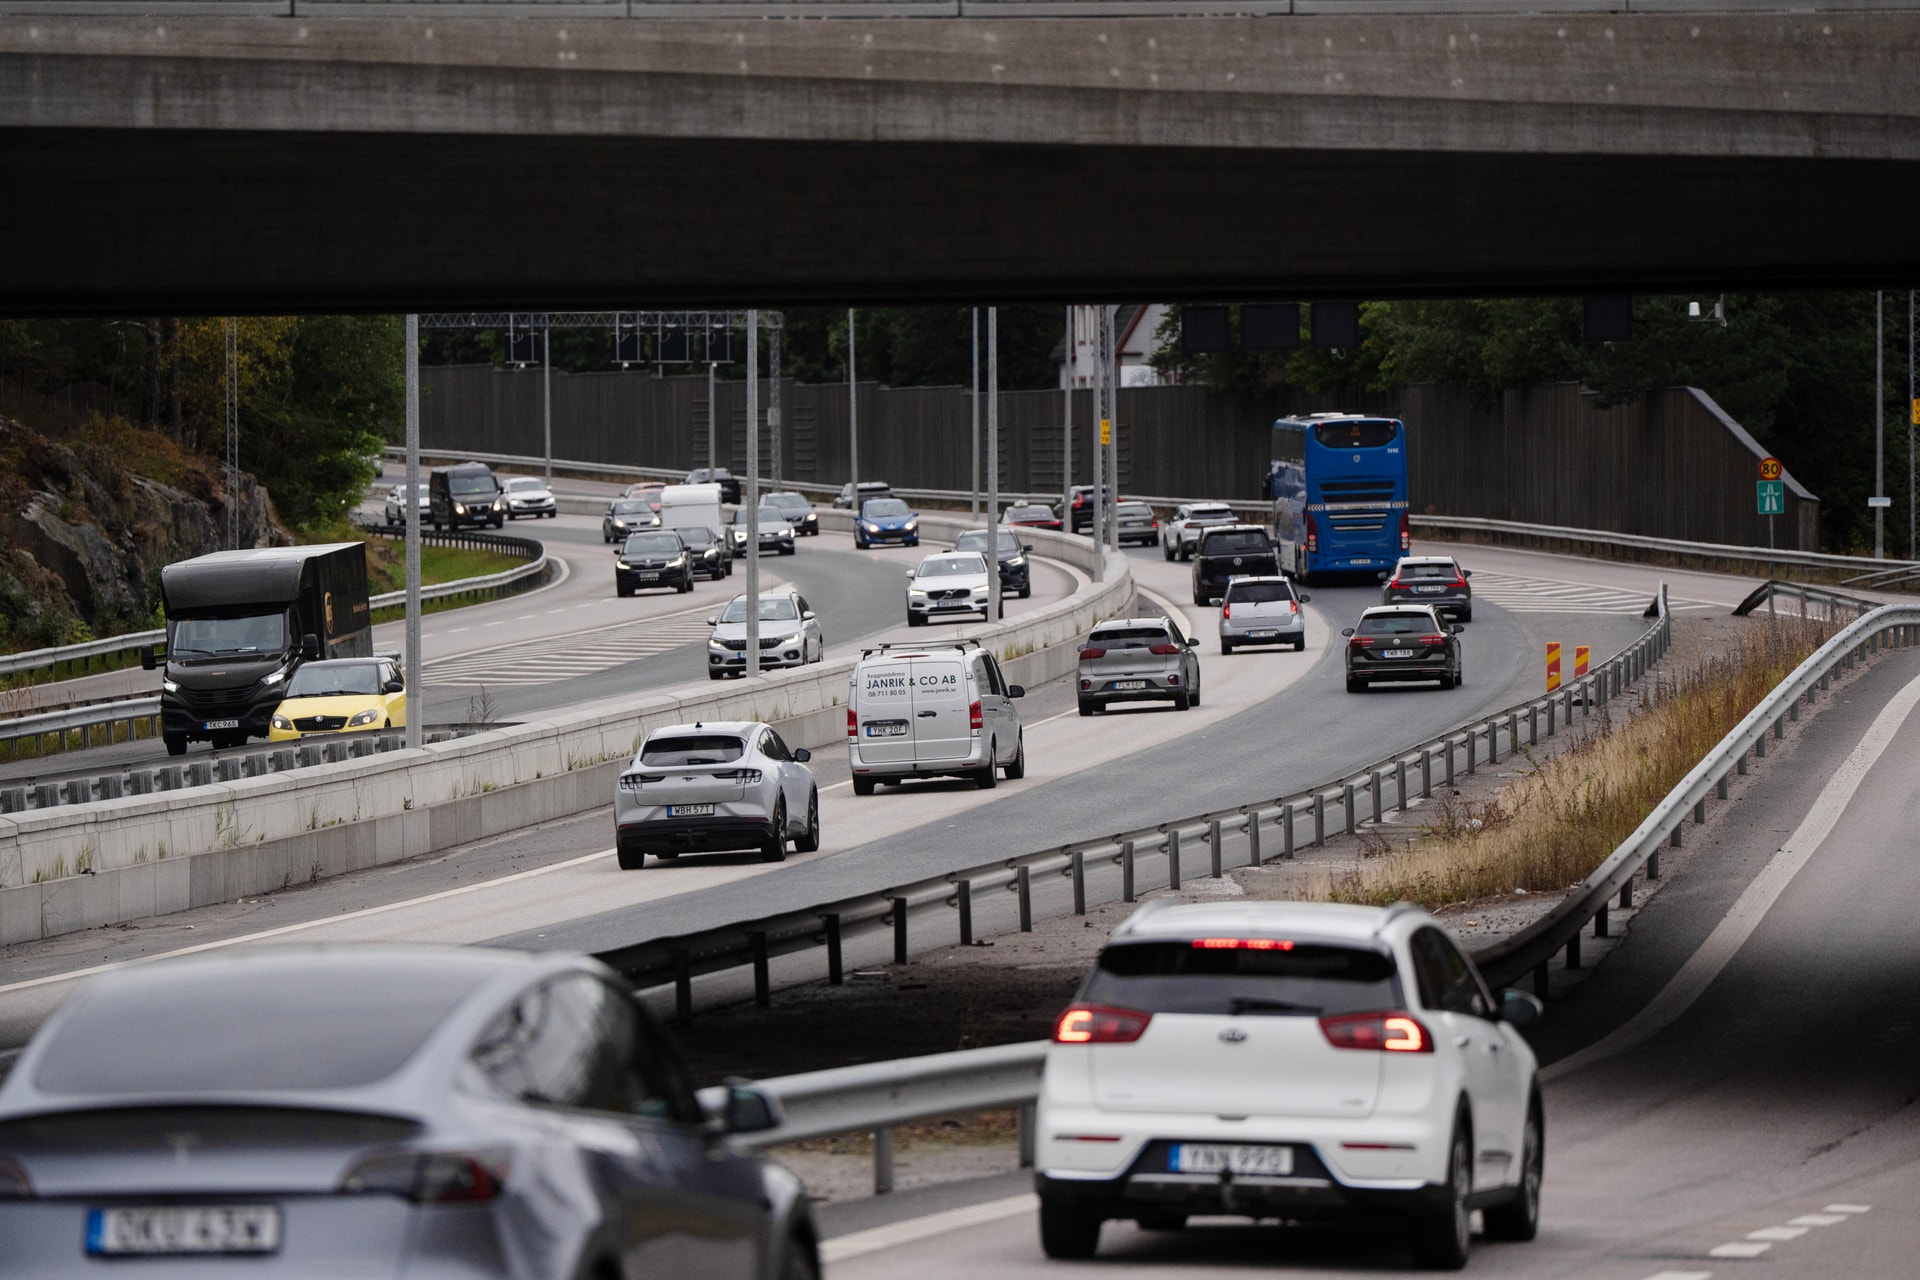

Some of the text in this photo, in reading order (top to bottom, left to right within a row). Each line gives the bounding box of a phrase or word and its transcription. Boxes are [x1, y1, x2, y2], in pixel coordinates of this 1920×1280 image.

[1762, 463, 1778, 475] 80
[866, 675, 957, 690] JANRIK & CO AB
[868, 690, 888, 698] 08-711
[873, 726, 887, 734] YHK
[674, 805, 710, 815] WBH 57T
